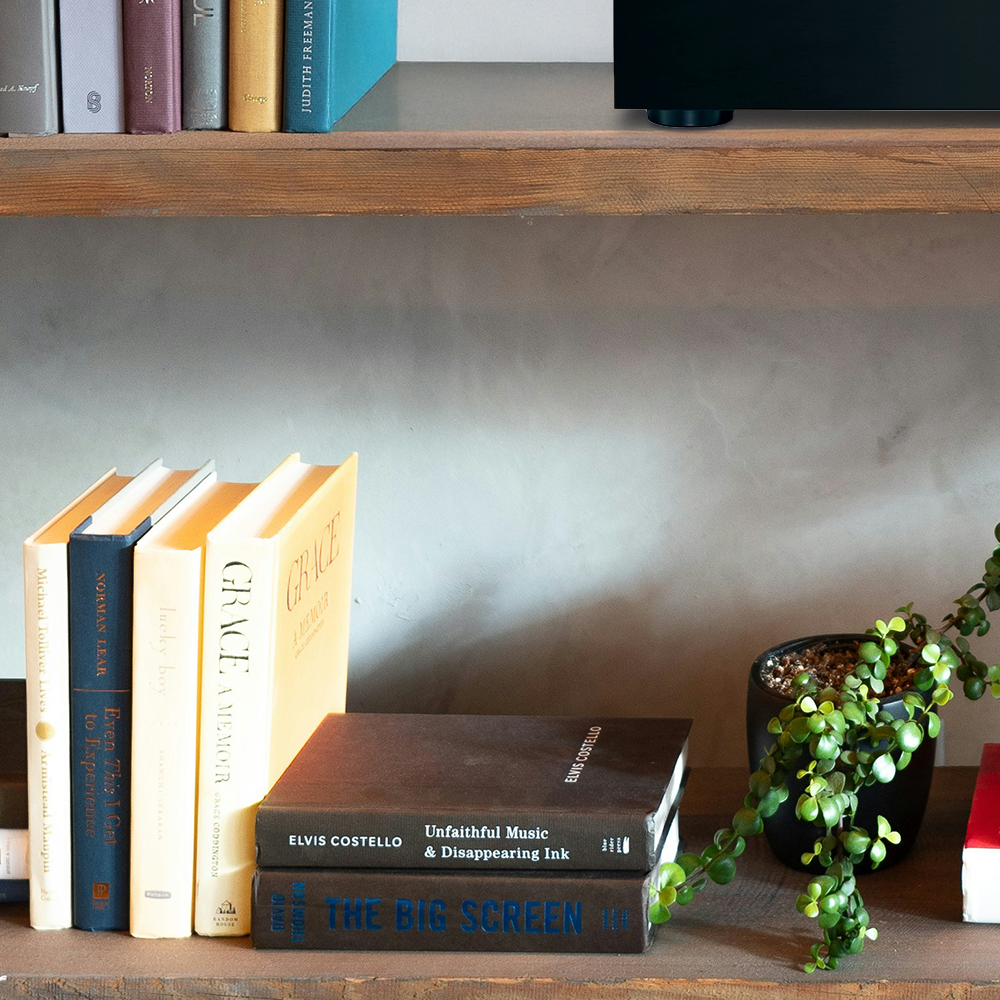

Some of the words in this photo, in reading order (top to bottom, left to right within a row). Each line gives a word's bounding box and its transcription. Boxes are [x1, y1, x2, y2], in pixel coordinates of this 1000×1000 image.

[302, 0, 314, 60] FREEMAN
[301, 65, 312, 113] JUDITH
[286, 509, 341, 613] GRACE
[36, 567, 49, 621] Michael
[95, 571, 107, 633] NORMAN
[217, 559, 254, 676] GRACE
[96, 638, 107, 677] LEAR
[38, 679, 49, 713] Lives
[103, 707, 121, 751] Even
[214, 702, 234, 785] MEMOIR
[564, 762, 585, 783] ELVIS
[575, 725, 602, 763] COSTELLO
[210, 821, 221, 879] CODDINGTON
[288, 834, 327, 847] ELVIS
[330, 835, 403, 848] COSTELLO
[423, 845, 437, 858] &
[441, 845, 540, 862] Disappearing
[544, 847, 570, 860] Ink
[424, 824, 501, 840] Unfaithful
[505, 825, 549, 840] Music
[323, 896, 382, 931] THE
[395, 898, 447, 933] BIG
[460, 898, 583, 935] SCREEN
